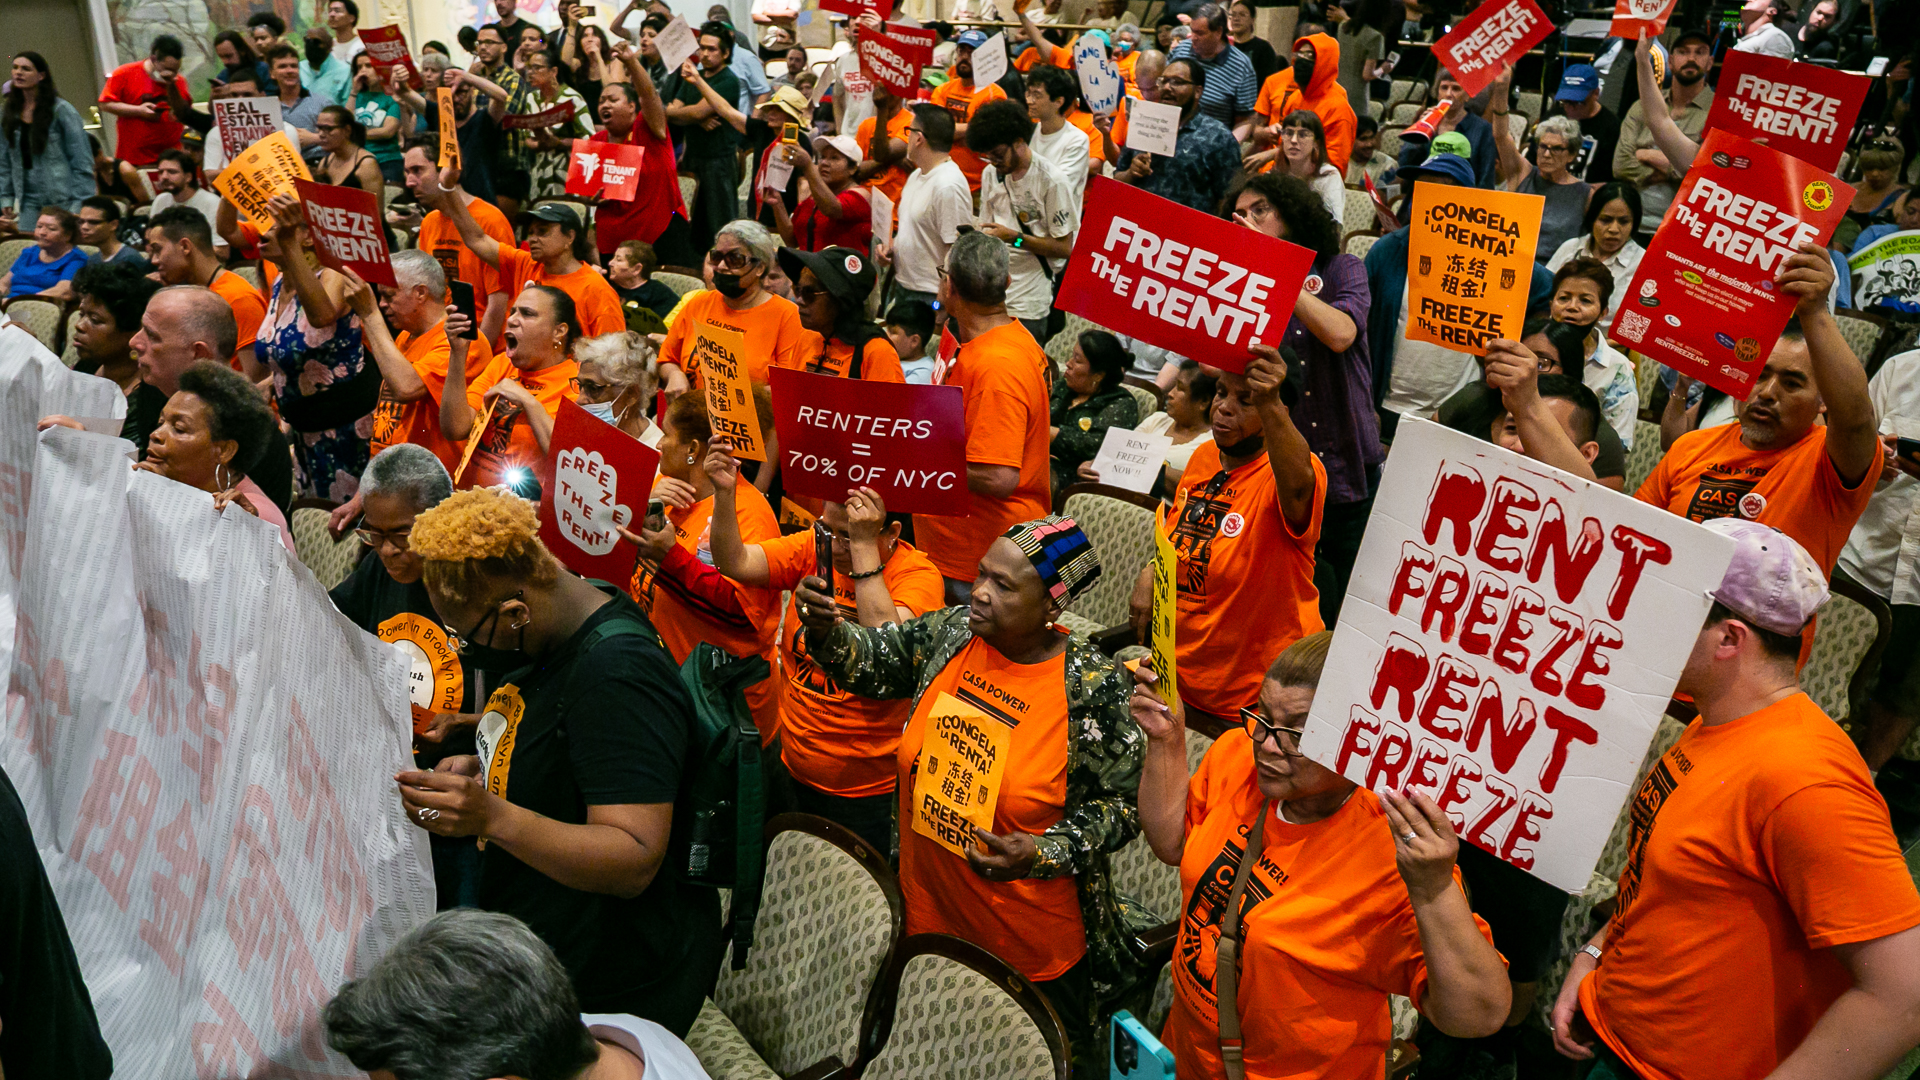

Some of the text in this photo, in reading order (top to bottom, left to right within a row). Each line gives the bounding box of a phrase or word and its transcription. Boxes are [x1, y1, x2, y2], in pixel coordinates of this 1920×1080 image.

[1449, 0, 1521, 63] FREEZE
[1459, 8, 1538, 74] THE RENT!
[868, 56, 911, 88] RENTA!
[215, 101, 260, 116] REAL
[1735, 73, 1842, 123] FREEZE
[218, 113, 272, 127] ESTATE
[1728, 97, 1839, 144] THE RENT!
[602, 163, 637, 177] TENANT
[602, 173, 625, 185] BLOC
[305, 199, 378, 240] FREEZE
[1424, 202, 1521, 238] ¡CONGELA
[1687, 176, 1820, 250] FREEZE
[328, 235, 386, 264] RENT!
[1431, 223, 1516, 257] LA RENTA!
[1675, 204, 1800, 277] THE RENT
[1879, 240, 1898, 252] THE
[1901, 237, 1920, 245] ROA
[1103, 215, 1276, 313] FREEZE
[1446, 253, 1488, 280] 冻结
[1665, 250, 1694, 268] TENANTS
[1693, 263, 1707, 273] ARE
[1706, 267, 1720, 279] the
[1719, 273, 1753, 294] majority
[1090, 251, 1271, 348] THE RENT!
[1440, 273, 1487, 298] 租金!
[706, 318, 722, 328] CASA
[1416, 316, 1438, 336] THE
[1420, 297, 1503, 334] FREEZE
[1742, 337, 1758, 348] VOTE
[797, 405, 933, 439] RENTERS
[851, 442, 871, 456] =
[1116, 451, 1149, 465] FREEZE
[1126, 439, 1150, 451] RENT
[789, 450, 957, 490] 70% OF NYC
[1112, 464, 1132, 475] NOW
[561, 456, 624, 525] FREEZE
[561, 480, 593, 520] THE
[1699, 489, 1738, 506] CAS
[562, 509, 610, 546] RENT!
[1422, 459, 1672, 621] RENT
[1389, 540, 1623, 711] FREEZE
[378, 619, 455, 711] Power in Brooklyn and
[962, 670, 1031, 714] CASA POWER!
[1369, 631, 1599, 794] RENT
[936, 714, 996, 761] ¡CONGELA
[940, 729, 993, 775] LA RENTA!
[492, 775, 501, 796] an
[947, 760, 974, 790] 冻结
[1335, 704, 1553, 871] FREEZE
[920, 810, 977, 850] THE RENT
